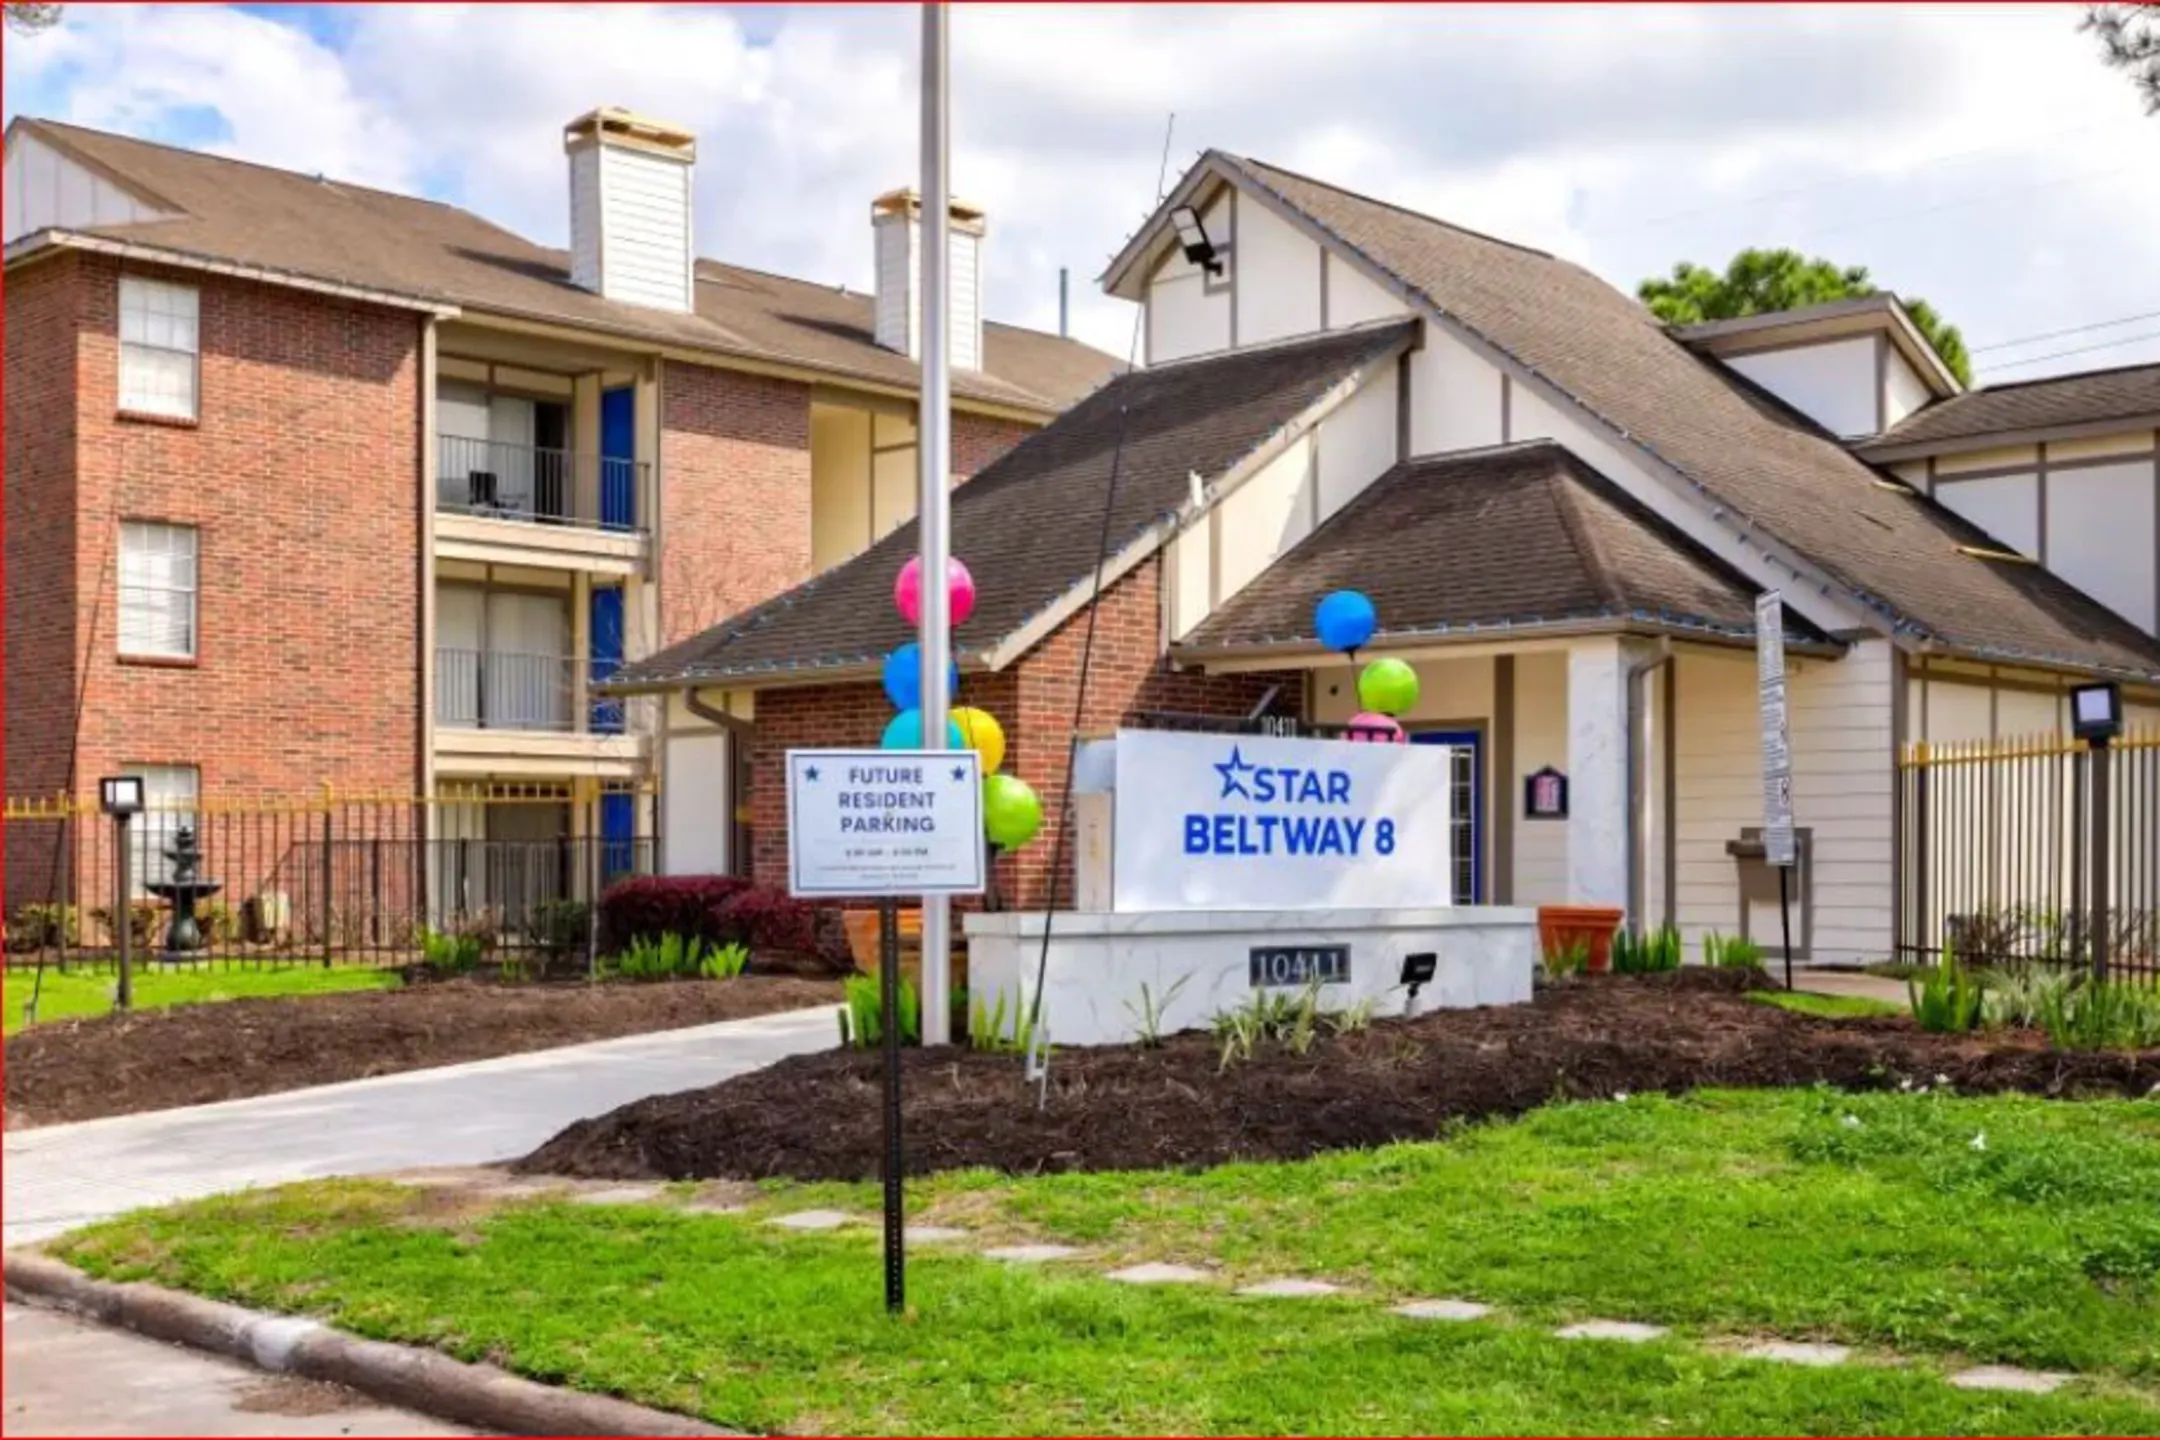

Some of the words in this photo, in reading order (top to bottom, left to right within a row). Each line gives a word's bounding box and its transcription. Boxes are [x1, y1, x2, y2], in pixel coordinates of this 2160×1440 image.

[849, 767, 924, 783] FUTURE
[1253, 768, 1351, 804] STAR
[838, 792, 935, 809] RESIDENT
[840, 816, 936, 833] PARKING
[1184, 814, 1366, 855] BELTWAY
[1375, 817, 1396, 855] 8
[1259, 950, 1341, 983] 10411
